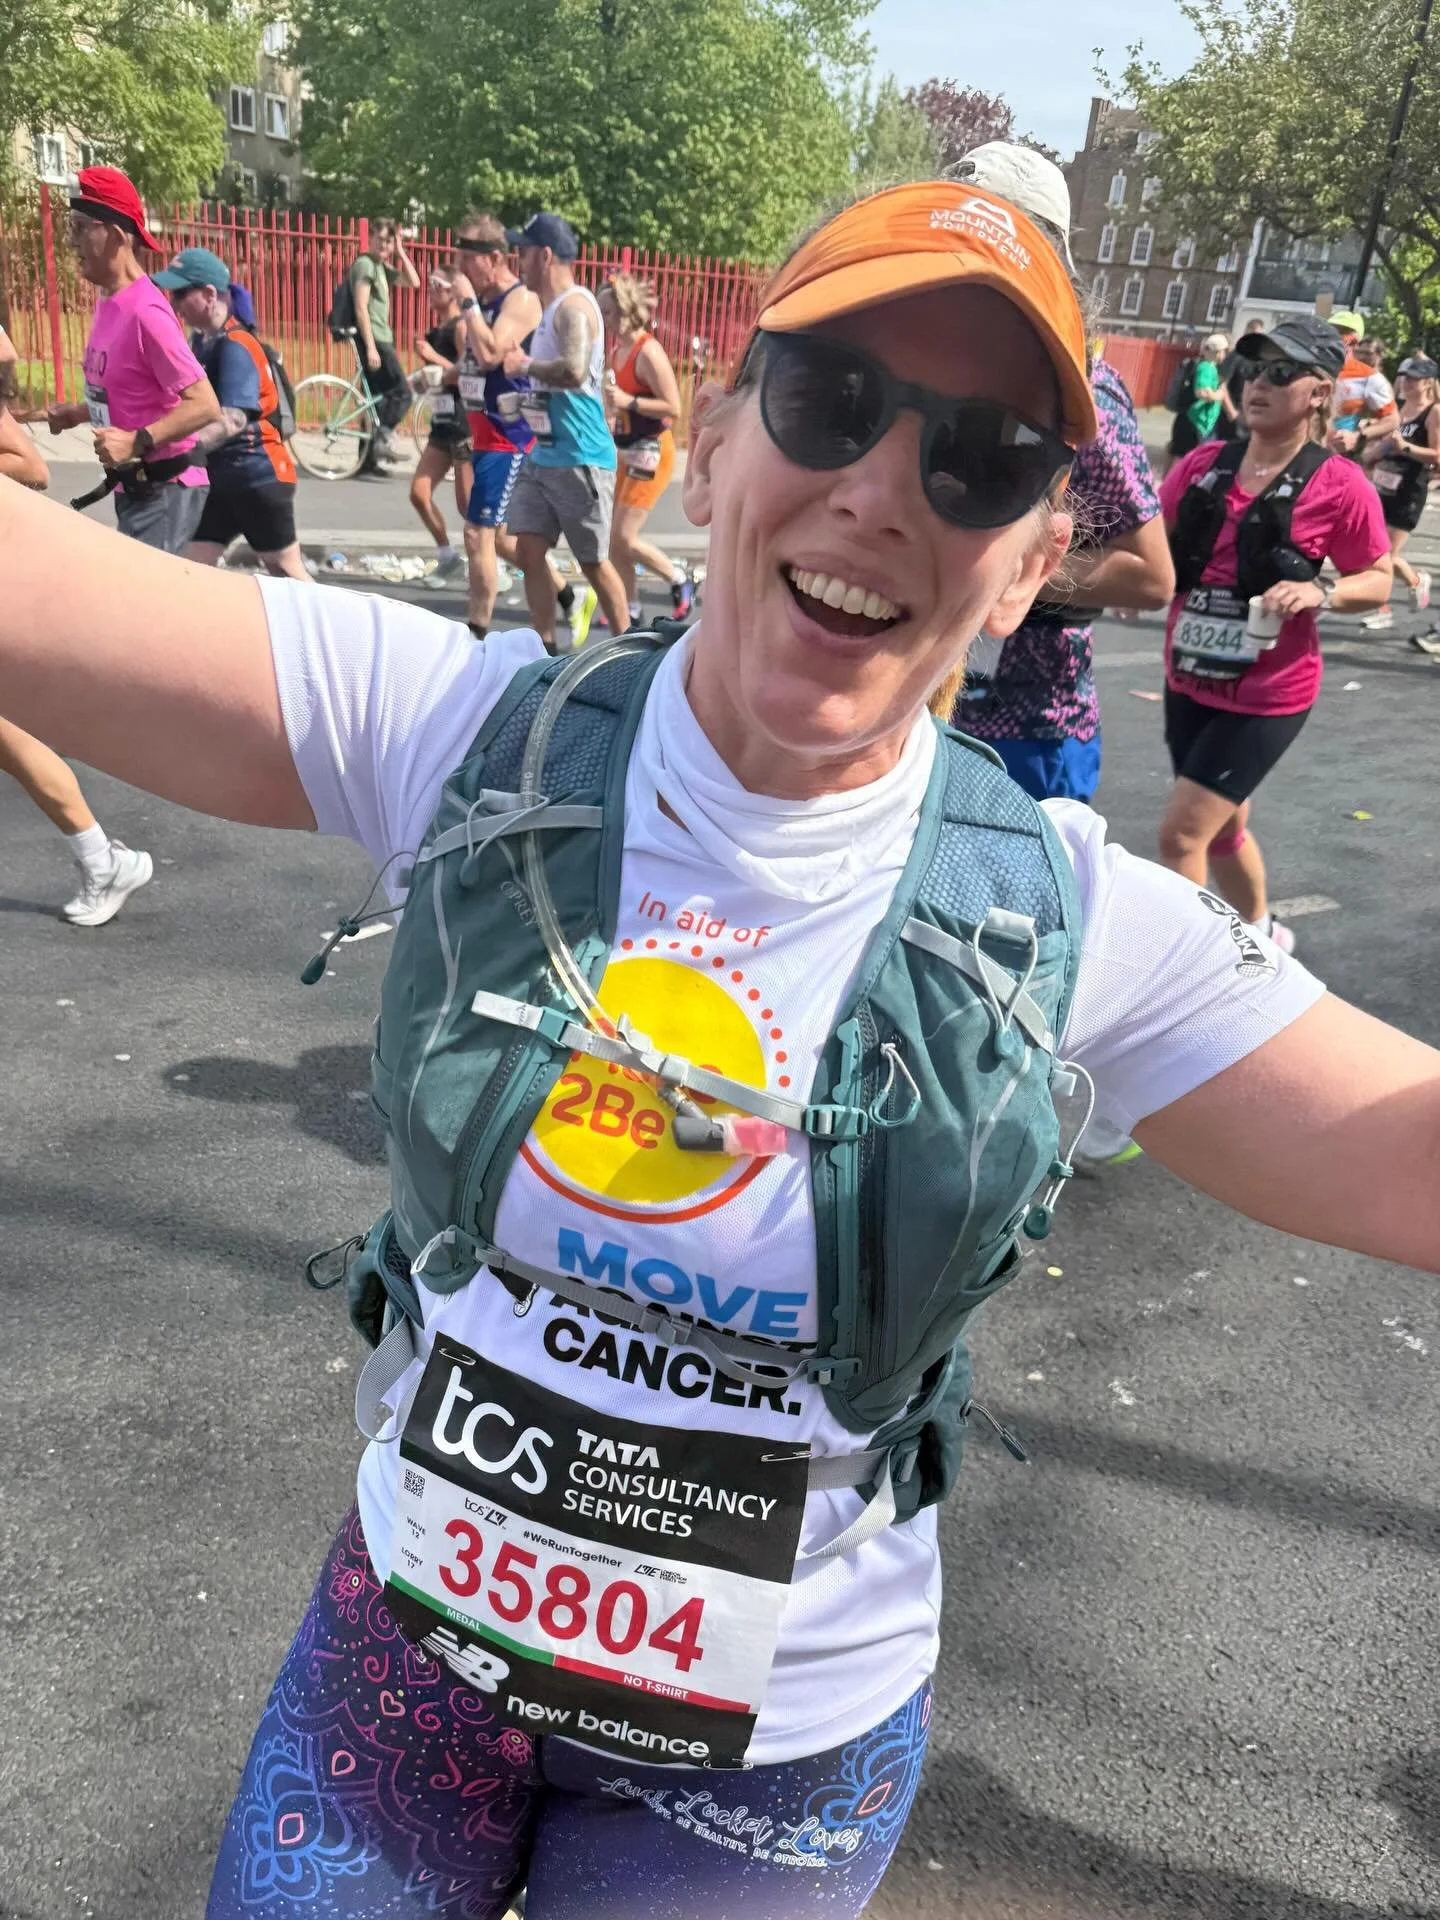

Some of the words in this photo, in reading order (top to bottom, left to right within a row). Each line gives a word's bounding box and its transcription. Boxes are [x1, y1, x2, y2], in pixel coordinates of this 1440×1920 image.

[930, 209, 1032, 265] MOUNTAIN
[1181, 622, 1243, 653] 83244
[638, 891, 667, 921] In
[676, 905, 727, 939] aid
[733, 925, 771, 947] of
[551, 1073, 666, 1149] 2Be
[558, 1228, 808, 1337] MOVE
[543, 1317, 802, 1416] CANCER.
[431, 1366, 554, 1495] tcs
[576, 1428, 661, 1468] TATA
[562, 1489, 693, 1537] SERVICES
[568, 1461, 777, 1521] CONSULTANCY
[406, 1516, 426, 1535] WAVE
[523, 1530, 622, 1568] #WeRunTogether
[401, 1547, 423, 1566] LORRY
[438, 1518, 705, 1674] 35804
[447, 1607, 481, 1631] MEDAL
[623, 1674, 643, 1687] NO
[645, 1680, 689, 1699] T-SHIRT
[507, 1694, 571, 1728] new
[577, 1709, 710, 1759] balance
[674, 1787, 775, 1845] Locket
[777, 1816, 863, 1857] Loves
[694, 1825, 747, 1854] HEALTHY.
[753, 1847, 769, 1860] BE
